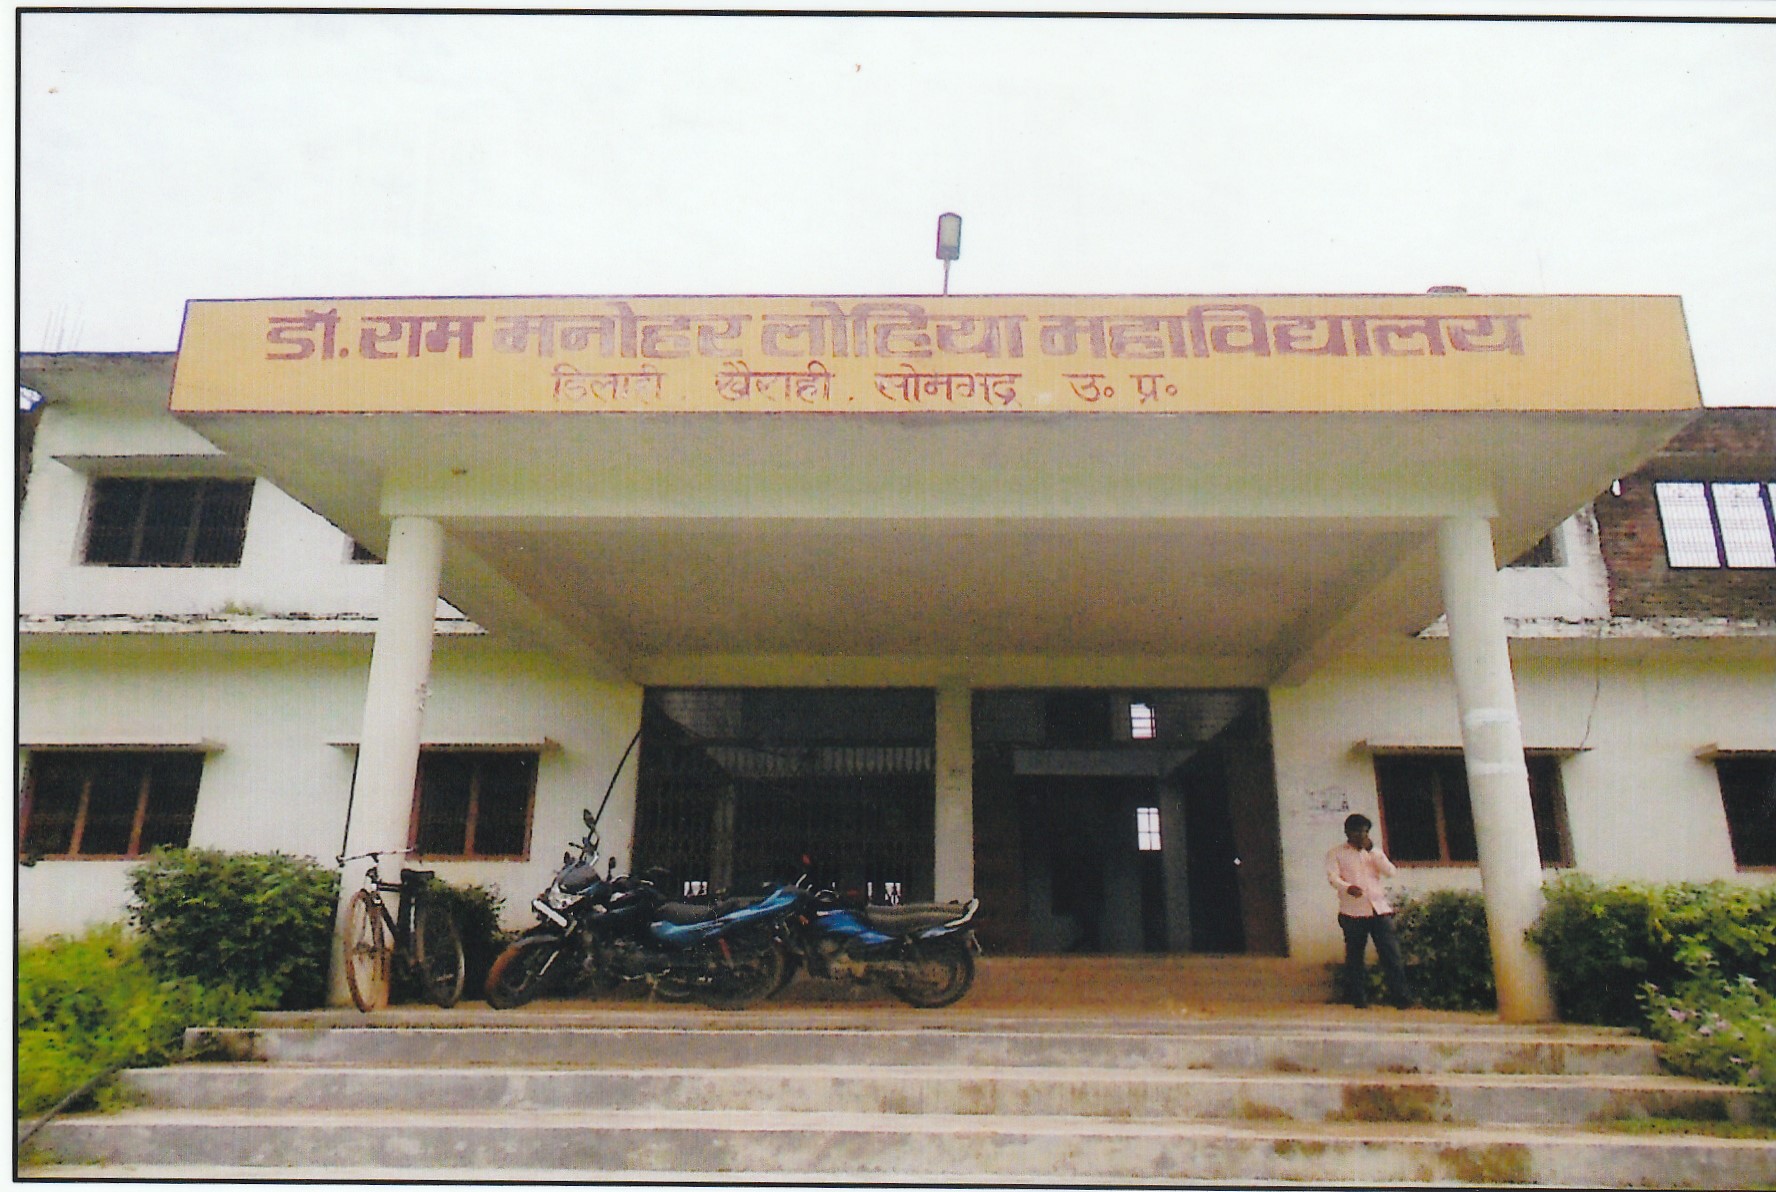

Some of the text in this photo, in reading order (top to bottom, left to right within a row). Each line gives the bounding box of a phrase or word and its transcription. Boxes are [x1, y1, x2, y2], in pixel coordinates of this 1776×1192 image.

[359, 315, 486, 360] राम
[492, 302, 752, 361] मनोहर
[760, 301, 1027, 360] लोहिया
[1039, 303, 1532, 359] महाविद्यालय
